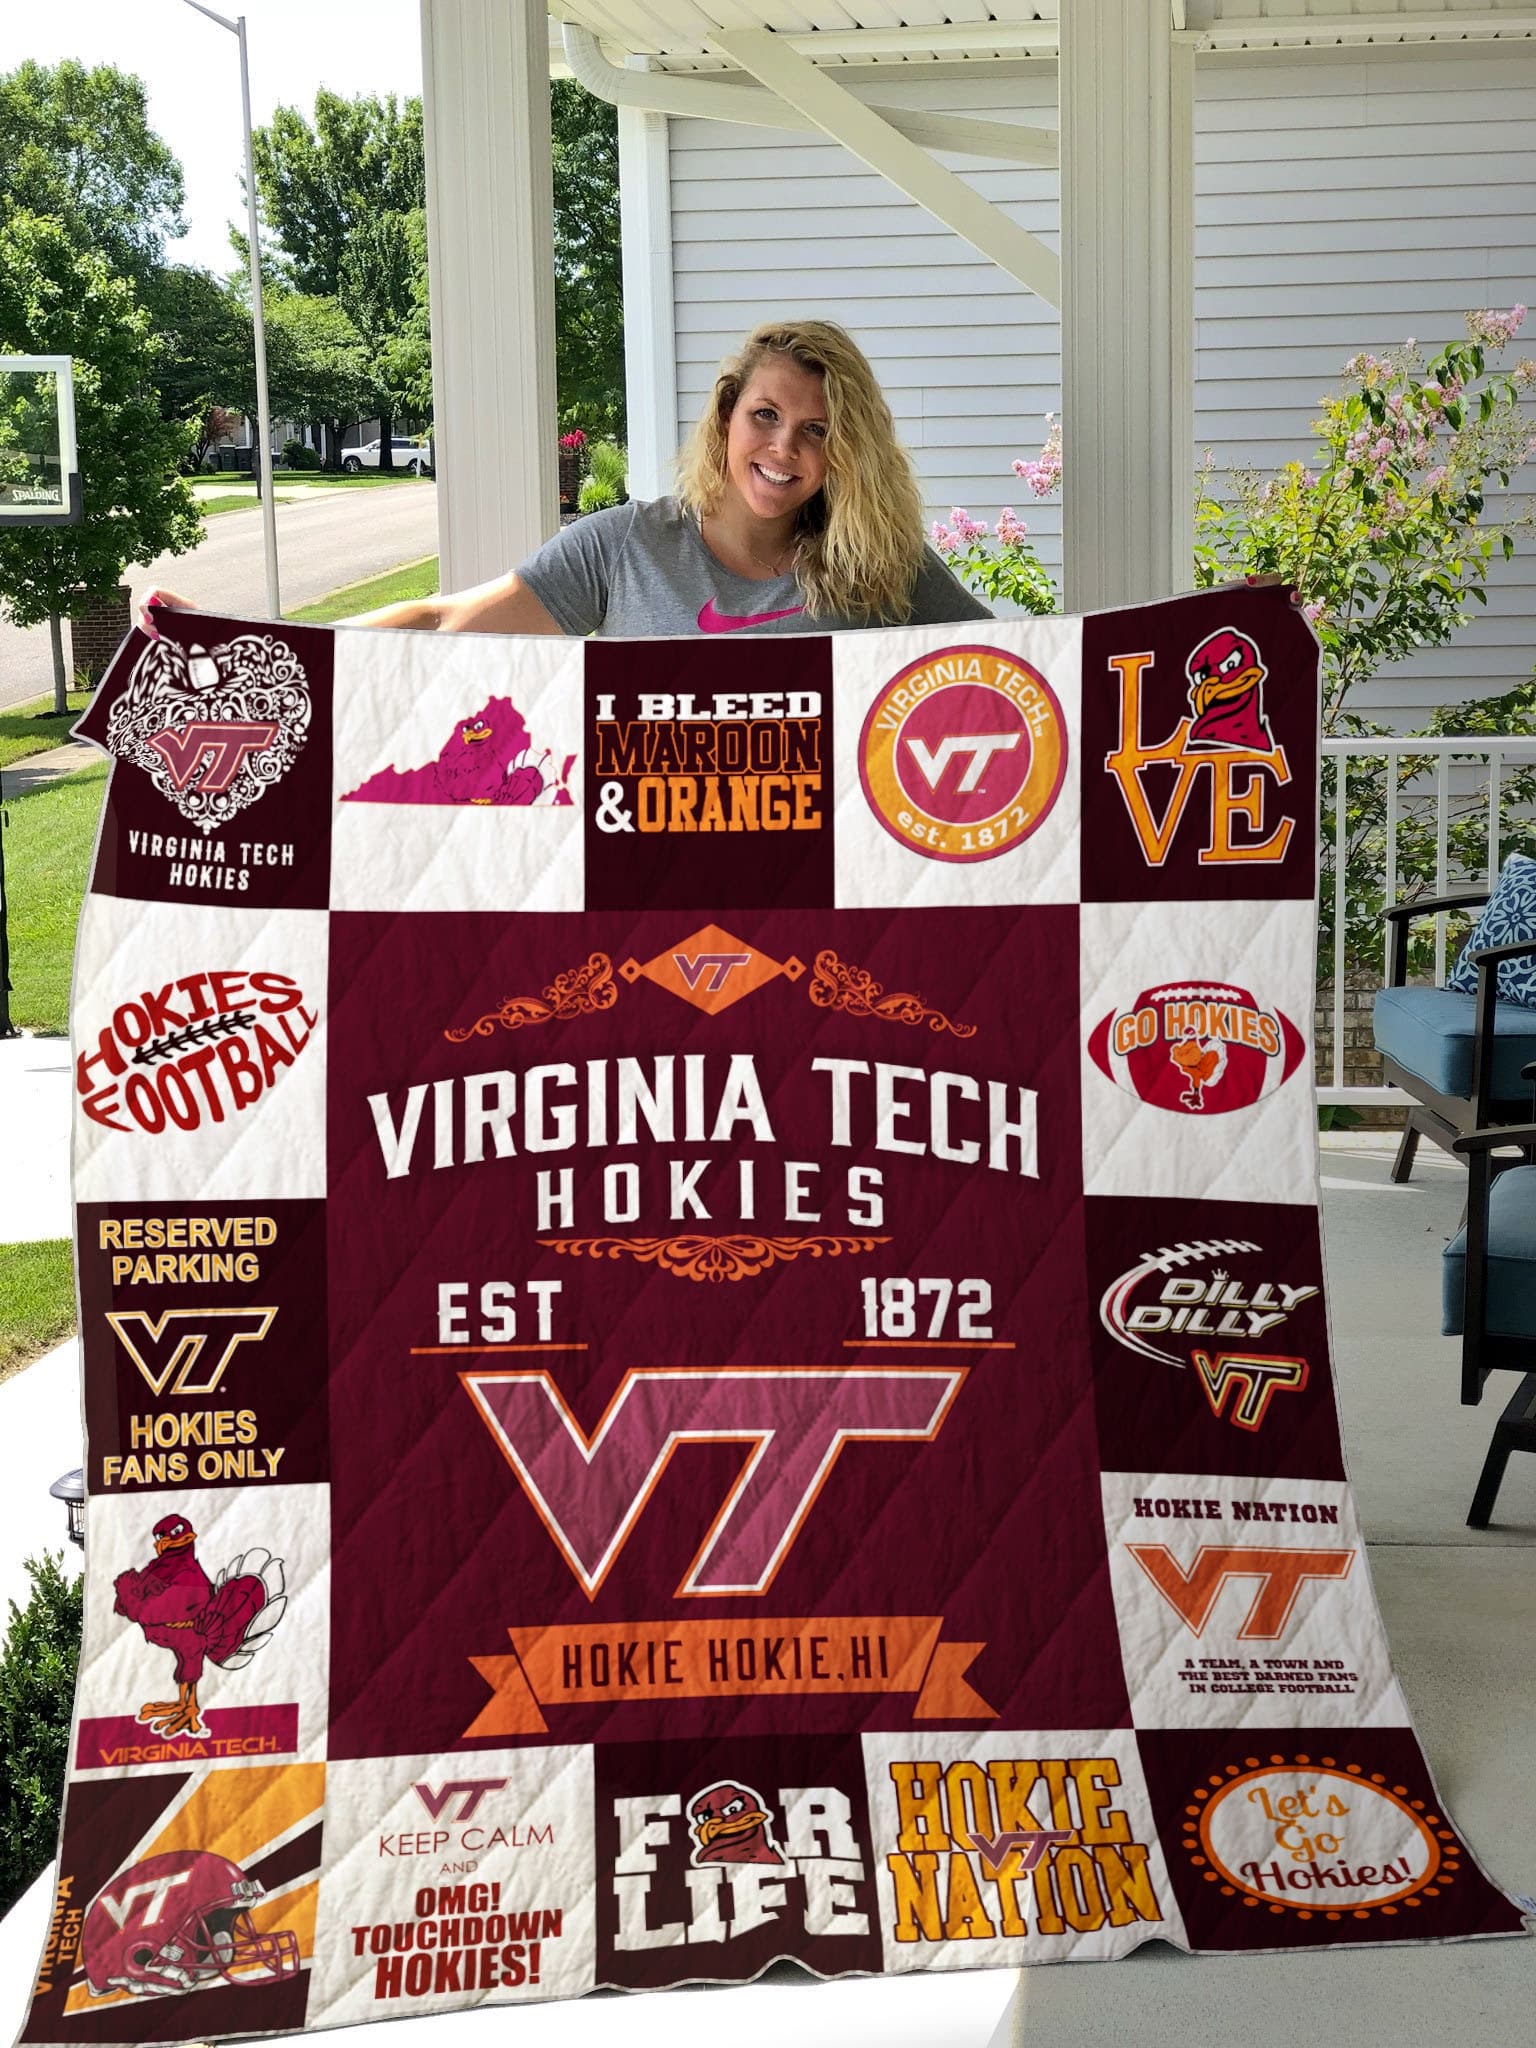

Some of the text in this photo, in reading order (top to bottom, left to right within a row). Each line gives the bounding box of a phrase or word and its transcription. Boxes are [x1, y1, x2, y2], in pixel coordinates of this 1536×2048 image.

[12, 489, 61, 502] SPALDING
[596, 691, 822, 721] I BLEED
[876, 658, 1051, 731] VIRGINIA TECH
[147, 721, 279, 794] VT
[596, 719, 822, 776] MAROON
[901, 731, 1025, 795] VT
[595, 775, 822, 834] & ORANGE
[128, 830, 295, 867] VIRGINIA TECH
[896, 806, 1031, 851] est. 1872
[169, 863, 250, 892] HOKIES
[672, 953, 752, 992] VT
[76, 971, 304, 1096] HOKIES
[1114, 1001, 1280, 1058] GO HOKIES
[81, 1006, 318, 1134] FOOTBALL
[366, 1054, 1040, 1181] VIRGINIA TECH
[536, 1159, 884, 1232] HOKIES
[99, 1217, 278, 1250] RESERVED
[112, 1253, 260, 1285] PARKING
[437, 1280, 563, 1345] EST
[860, 1277, 994, 1340] 1872
[1160, 1277, 1320, 1311] DILLY
[1125, 1305, 1288, 1338] DILLY
[1190, 1349, 1310, 1433] VT
[130, 1410, 258, 1449] HOKIES
[103, 1448, 286, 1486] FANS ONLY
[457, 1365, 972, 1603] VT
[1133, 1498, 1339, 1524] HOKIE NATION
[1124, 1543, 1357, 1641] VT
[562, 1638, 684, 1689] HOKIE
[1178, 1671, 1359, 1682] THE BEST DARNED FANS
[1184, 1658, 1345, 1670] A TEAM, A TOWN AND
[1189, 1683, 1207, 1693] IN
[1210, 1683, 1275, 1693] COLLEGE
[98, 1736, 278, 1766] VIRGINIA TECH
[410, 1776, 512, 1824] VT
[889, 1758, 1134, 1852] HOKIE
[1247, 1785, 1351, 1825] Let's
[379, 1824, 555, 1858] KEEP CALM
[966, 1829, 1076, 1872] VT
[1274, 1823, 1345, 1863] Go
[439, 1860, 479, 1875] AND
[1239, 1857, 1420, 1892] Hokies!
[99, 1867, 195, 1935] VT
[415, 1882, 501, 1918] OMG!
[613, 1858, 871, 1951] LIFE
[887, 1843, 1164, 1942] NATION
[57, 1908, 83, 1965] TECH
[351, 1908, 563, 1956] TOUCHDOWN
[374, 1943, 542, 2000] HOKIES!
